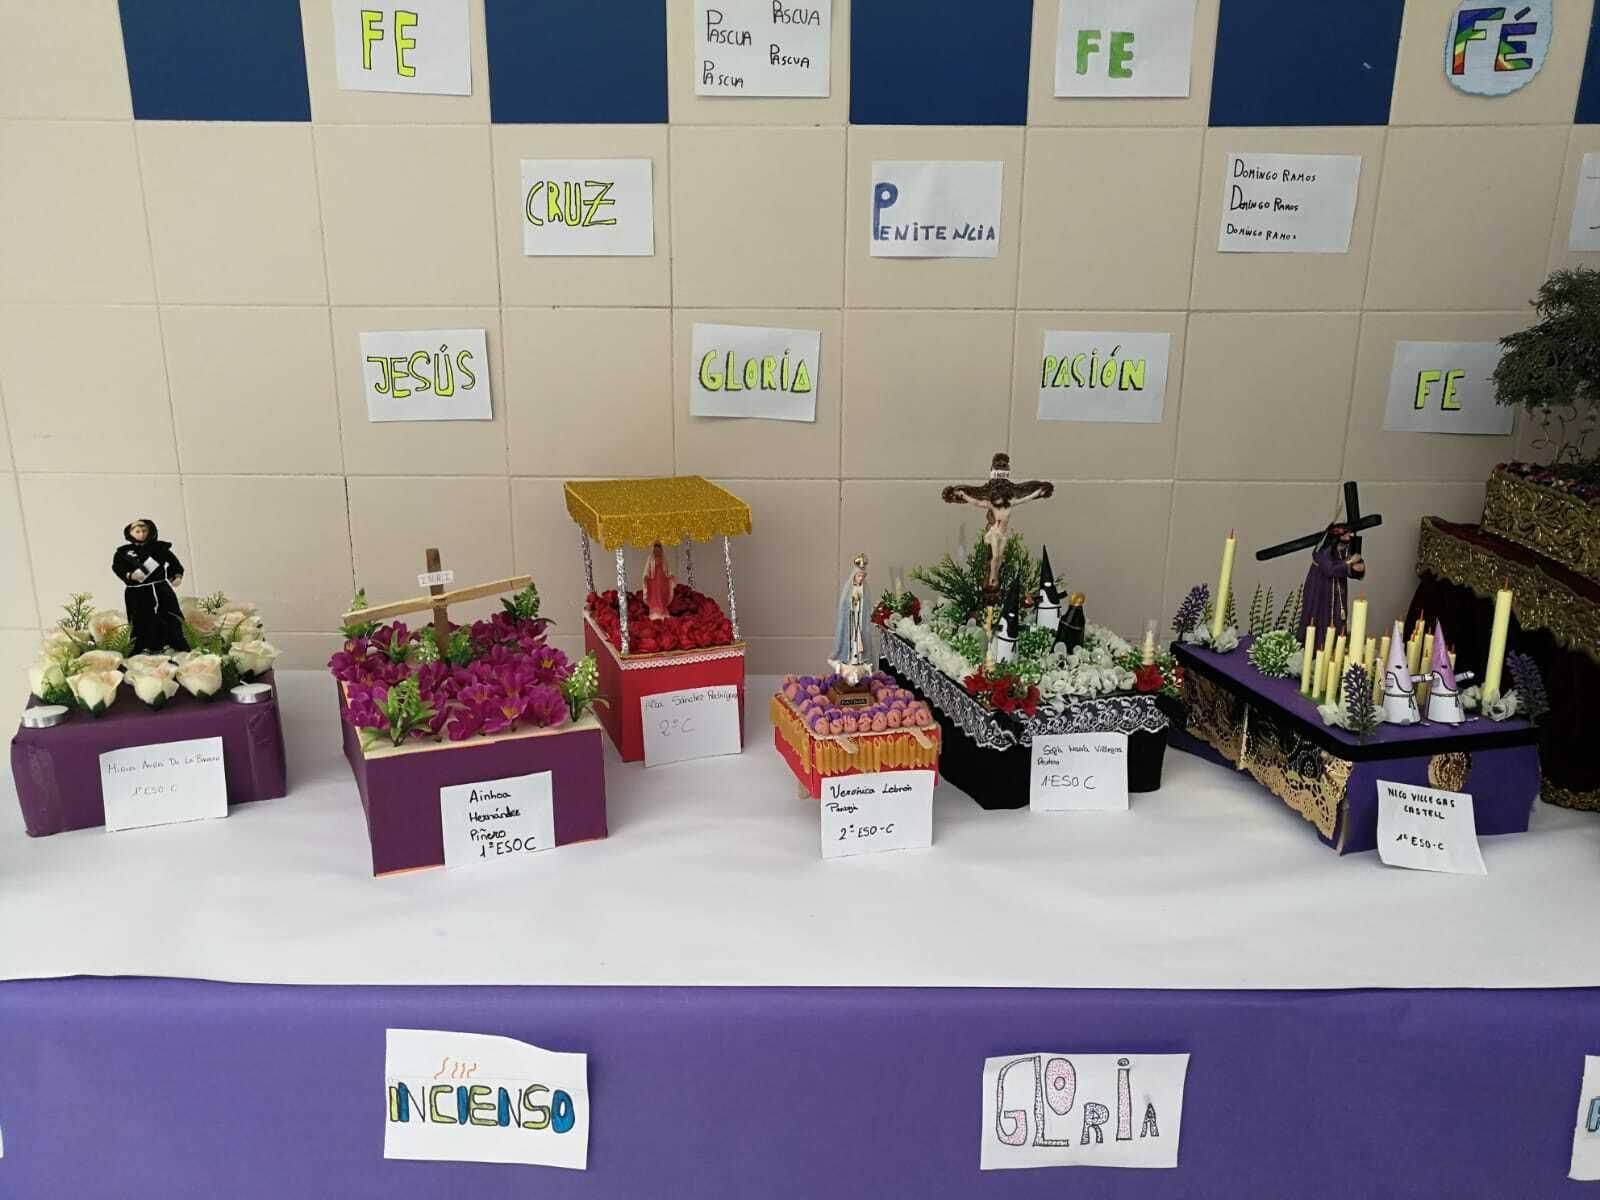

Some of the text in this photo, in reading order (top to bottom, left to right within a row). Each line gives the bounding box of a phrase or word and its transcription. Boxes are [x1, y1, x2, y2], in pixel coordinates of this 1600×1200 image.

[707, 9, 752, 46] PASCUA
[772, 0, 821, 25] PASCUA
[361, 10, 418, 77] FE
[770, 43, 810, 68] PASCUA
[1076, 30, 1135, 78] FE
[1452, 6, 1537, 75] FÉ
[702, 60, 744, 88] PASCUA
[1282, 169, 1316, 182] RAMOS
[526, 180, 617, 227] CRUZ
[873, 182, 995, 241] PENITENCIA
[367, 344, 476, 398] JESÚS
[1041, 344, 1146, 391] PASIÓN
[1415, 369, 1465, 411] FE
[469, 789, 511, 803] Ainhoa
[1388, 787, 1407, 799] NICO
[1404, 804, 1445, 819] CASTELL
[470, 828, 506, 841] Piñero
[389, 1082, 576, 1134] INCIENSO
